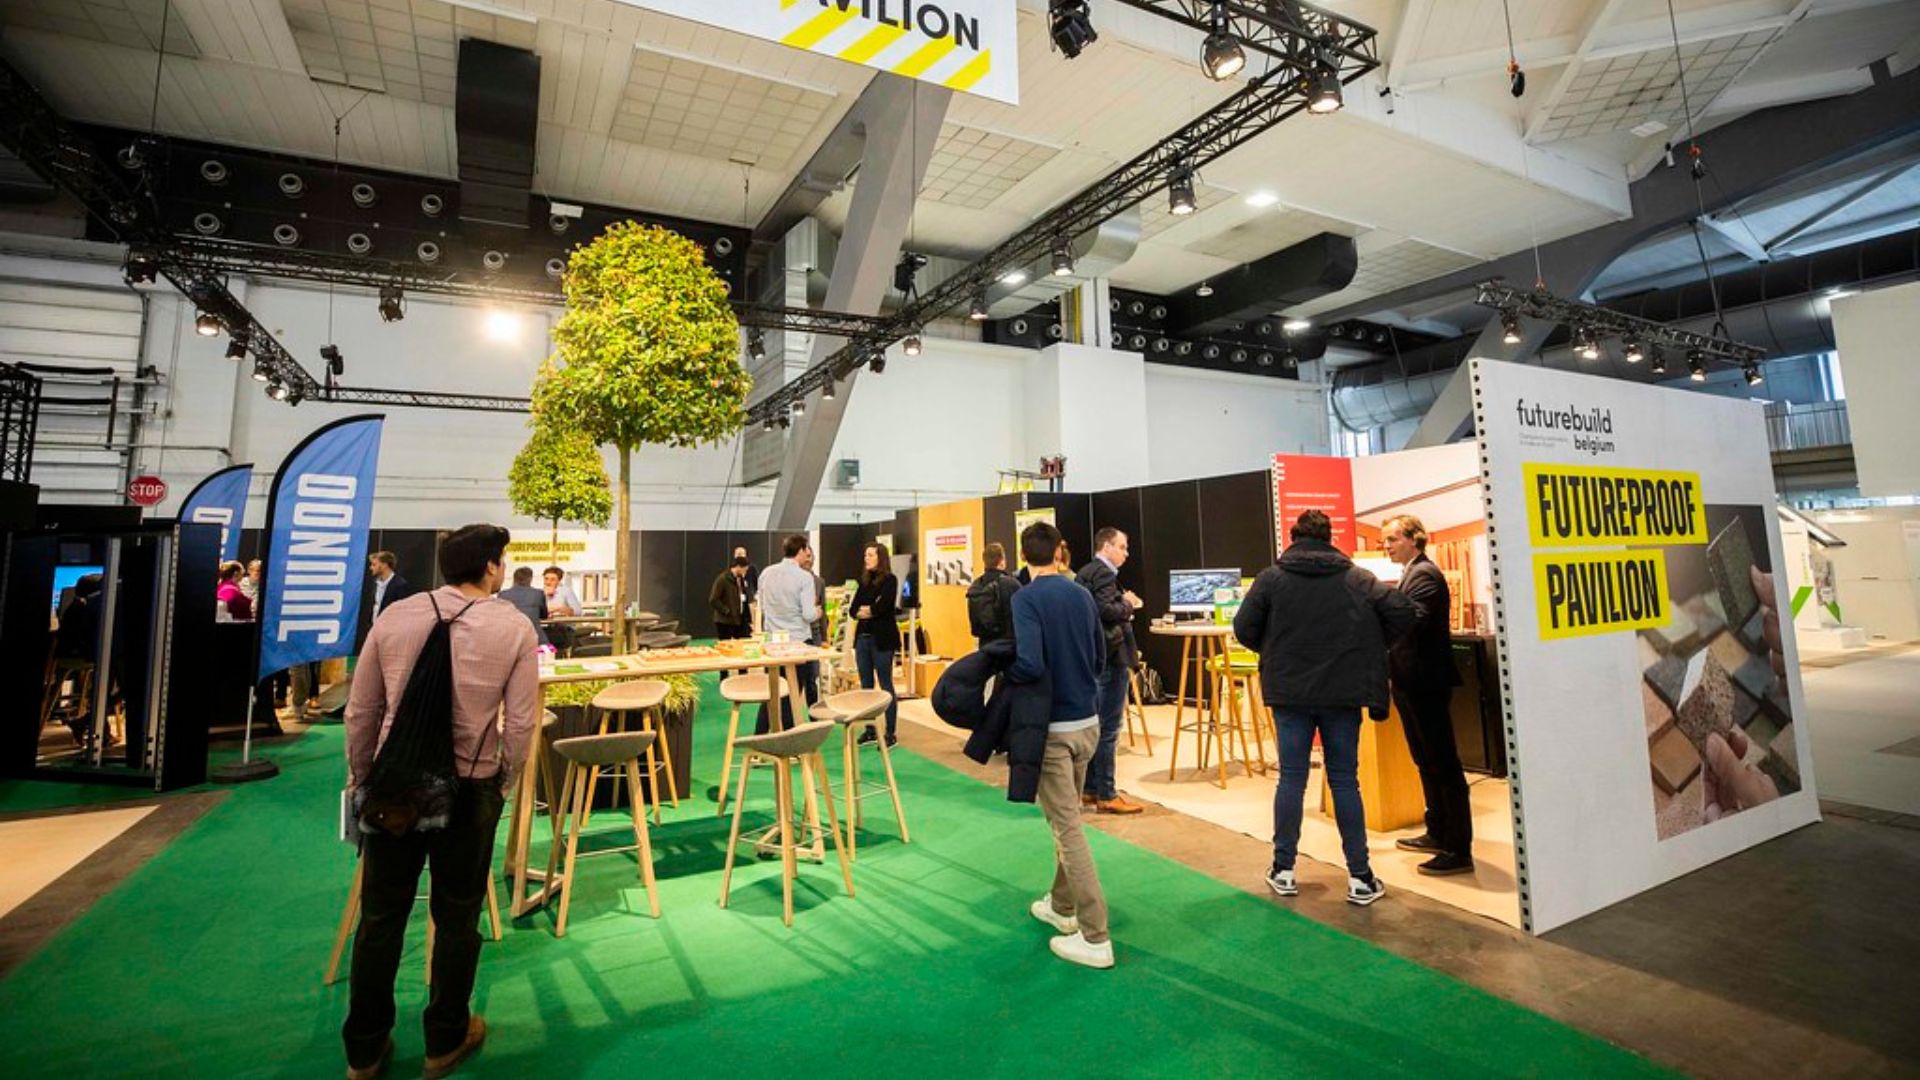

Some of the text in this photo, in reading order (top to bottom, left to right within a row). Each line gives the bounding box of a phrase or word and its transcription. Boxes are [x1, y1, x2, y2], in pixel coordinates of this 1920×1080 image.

[1517, 399, 1613, 433] futurebuild
[1574, 434, 1615, 455] belgium
[130, 484, 164, 496] STOP
[1536, 474, 1696, 537] FUTUREPROOF
[277, 473, 357, 644] JUUNOO
[1546, 560, 1660, 629] PAVILION
